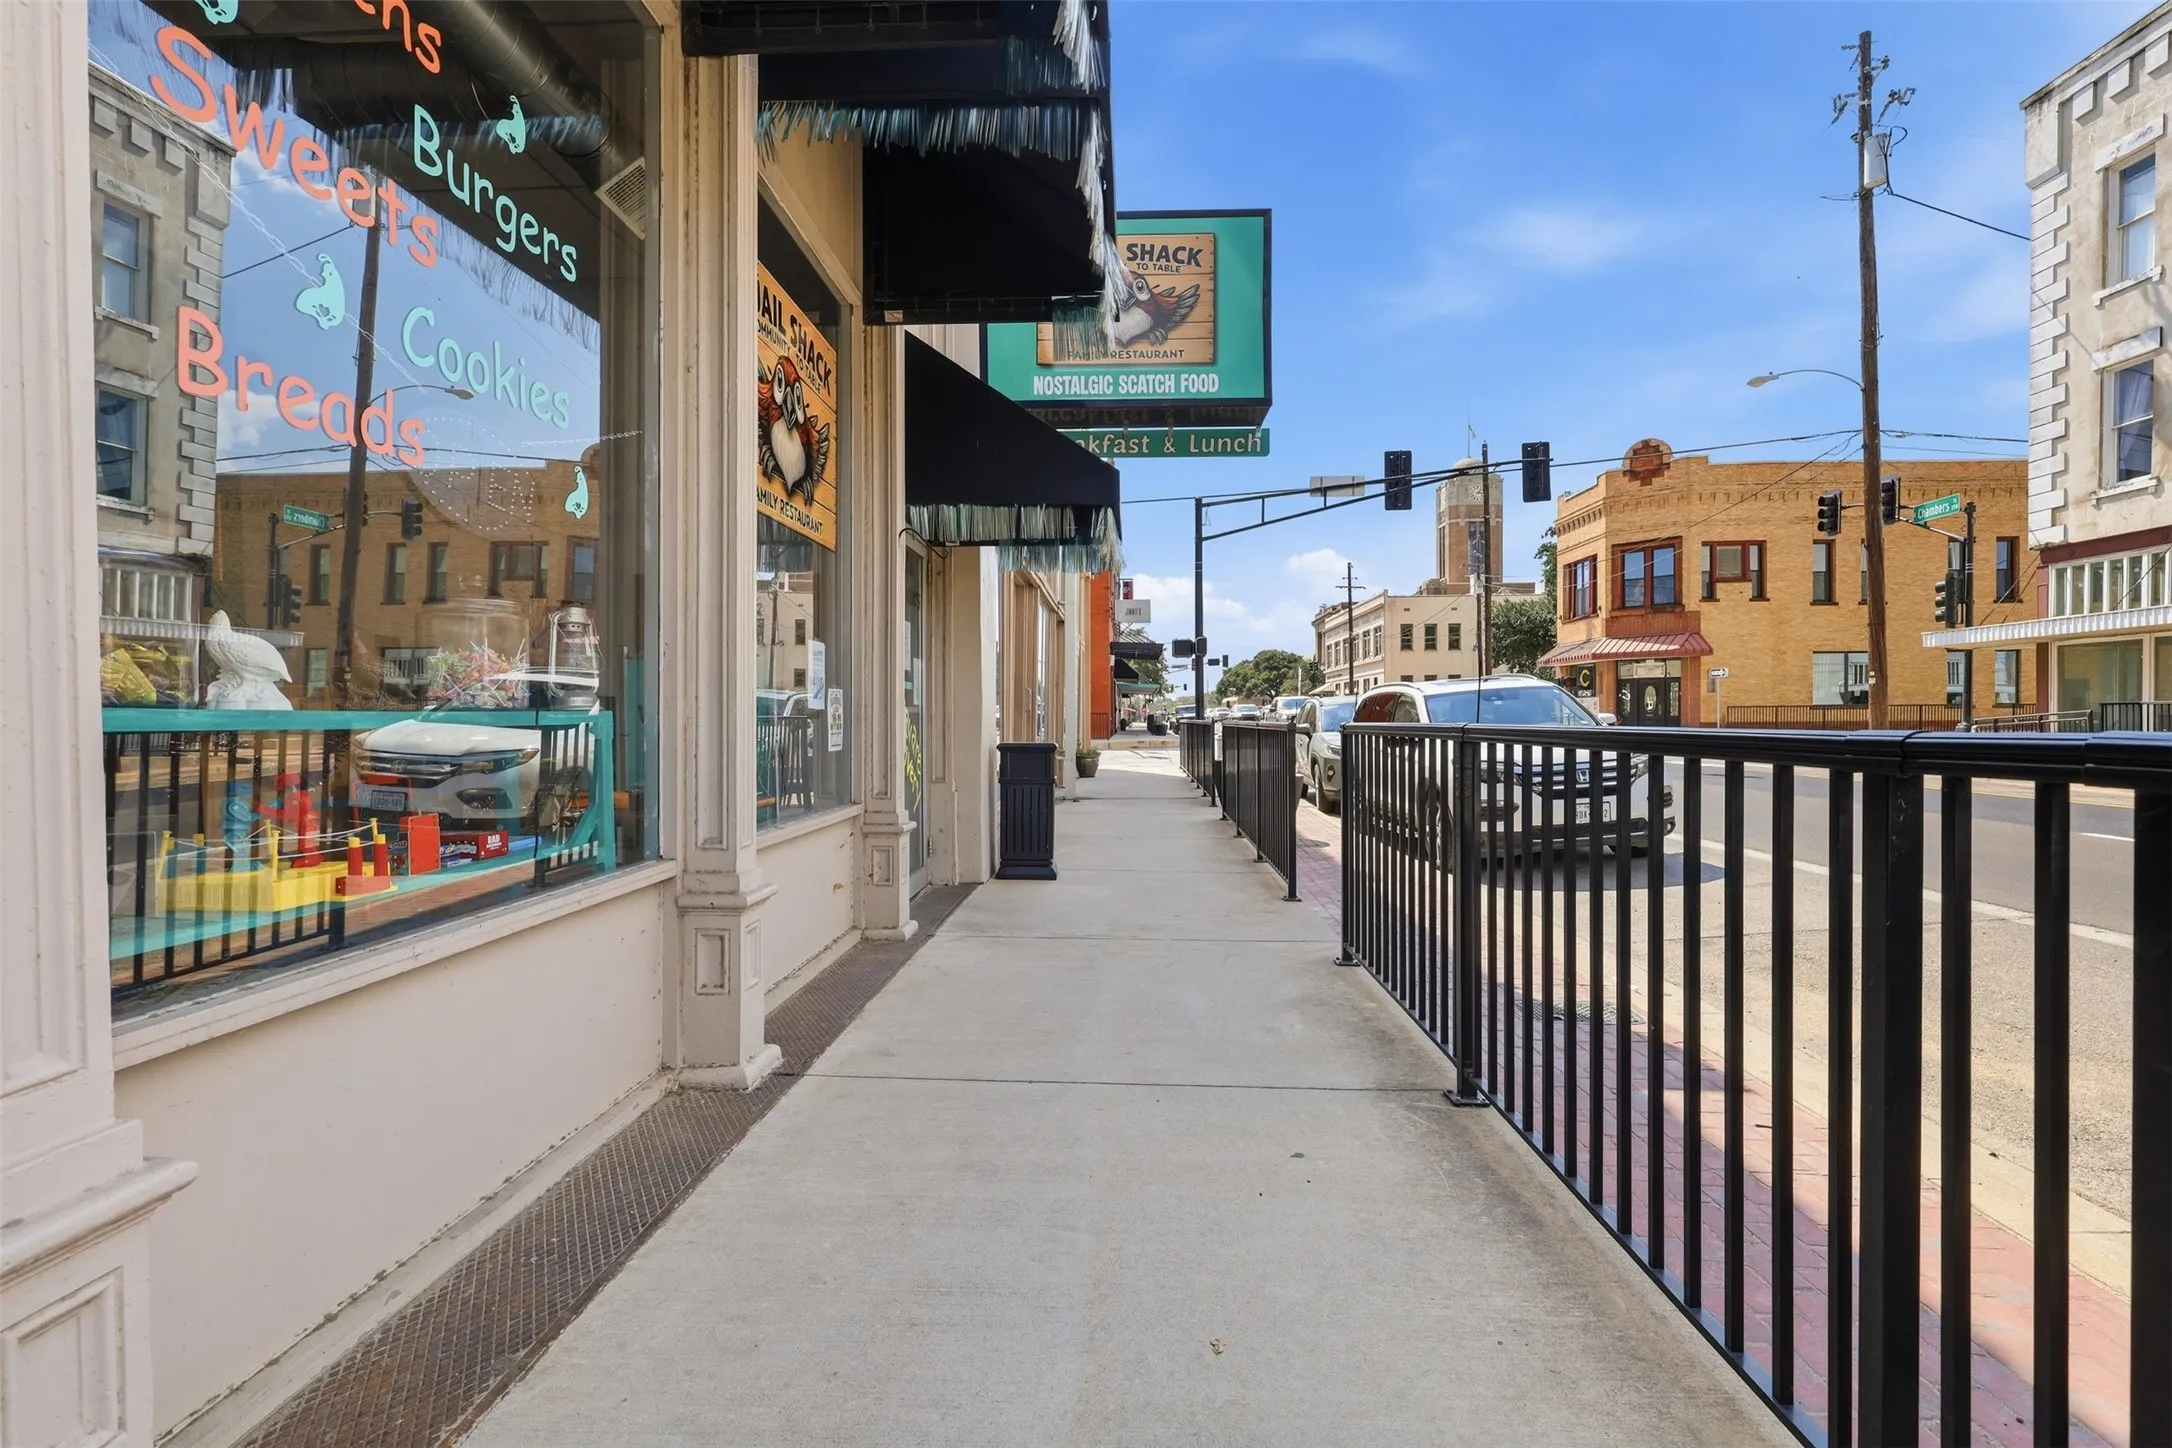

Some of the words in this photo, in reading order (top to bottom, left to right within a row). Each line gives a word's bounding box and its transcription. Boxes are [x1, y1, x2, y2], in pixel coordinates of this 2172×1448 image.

[149, 26, 438, 268] Sweets
[412, 103, 578, 284] Burgers
[1126, 242, 1204, 269] SHACK
[1136, 261, 1149, 271] TO
[1153, 262, 1182, 274] TABLE
[402, 306, 570, 430] Cookies
[789, 313, 832, 398] SHACK
[795, 352, 805, 373] TO
[1110, 349, 1185, 360] RESTAURANT
[176, 304, 425, 467] Breads
[1033, 375, 1114, 396] NOSTALGIC
[1118, 374, 1176, 395] SCATCH
[1180, 373, 1220, 393] FOOD
[1163, 436, 1176, 454] &
[1189, 432, 1261, 454] Lunch
[780, 498, 823, 534] RESTAURANT
[1918, 503, 1950, 519] Chambers
